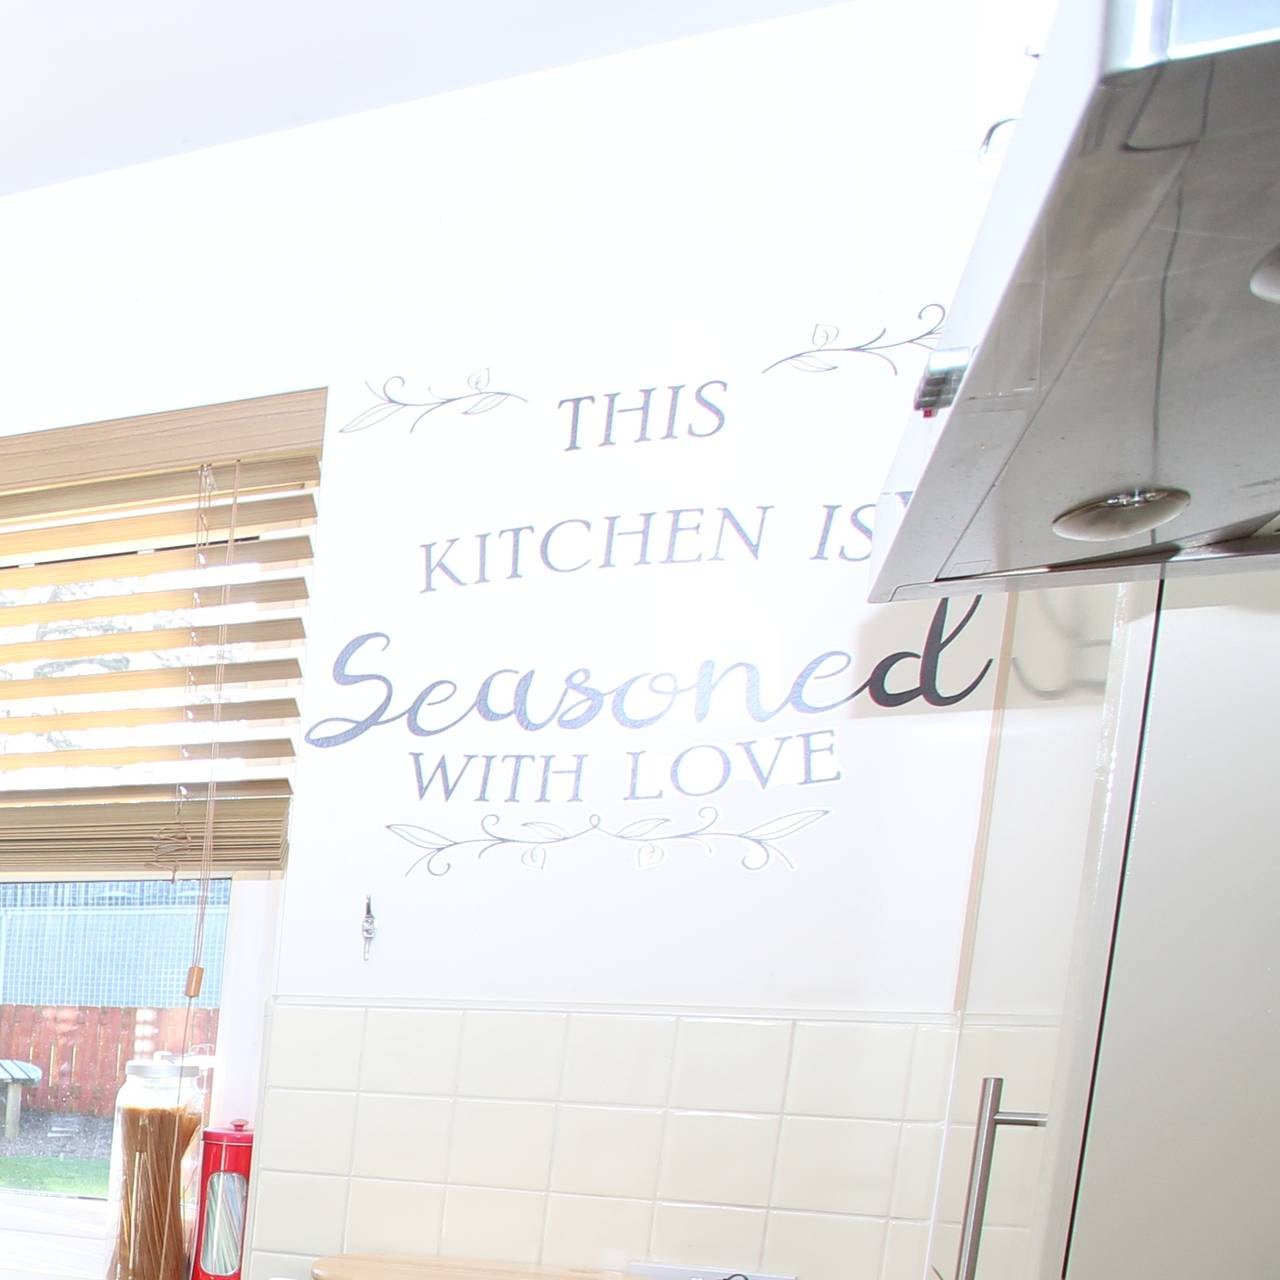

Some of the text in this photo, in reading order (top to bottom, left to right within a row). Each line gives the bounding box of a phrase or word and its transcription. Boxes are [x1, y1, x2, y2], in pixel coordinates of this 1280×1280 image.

[557, 380, 728, 451] THIS
[419, 503, 877, 594] KITCHEN IS
[304, 594, 993, 748] Seasoned
[408, 729, 842, 804] WITH LOVE
